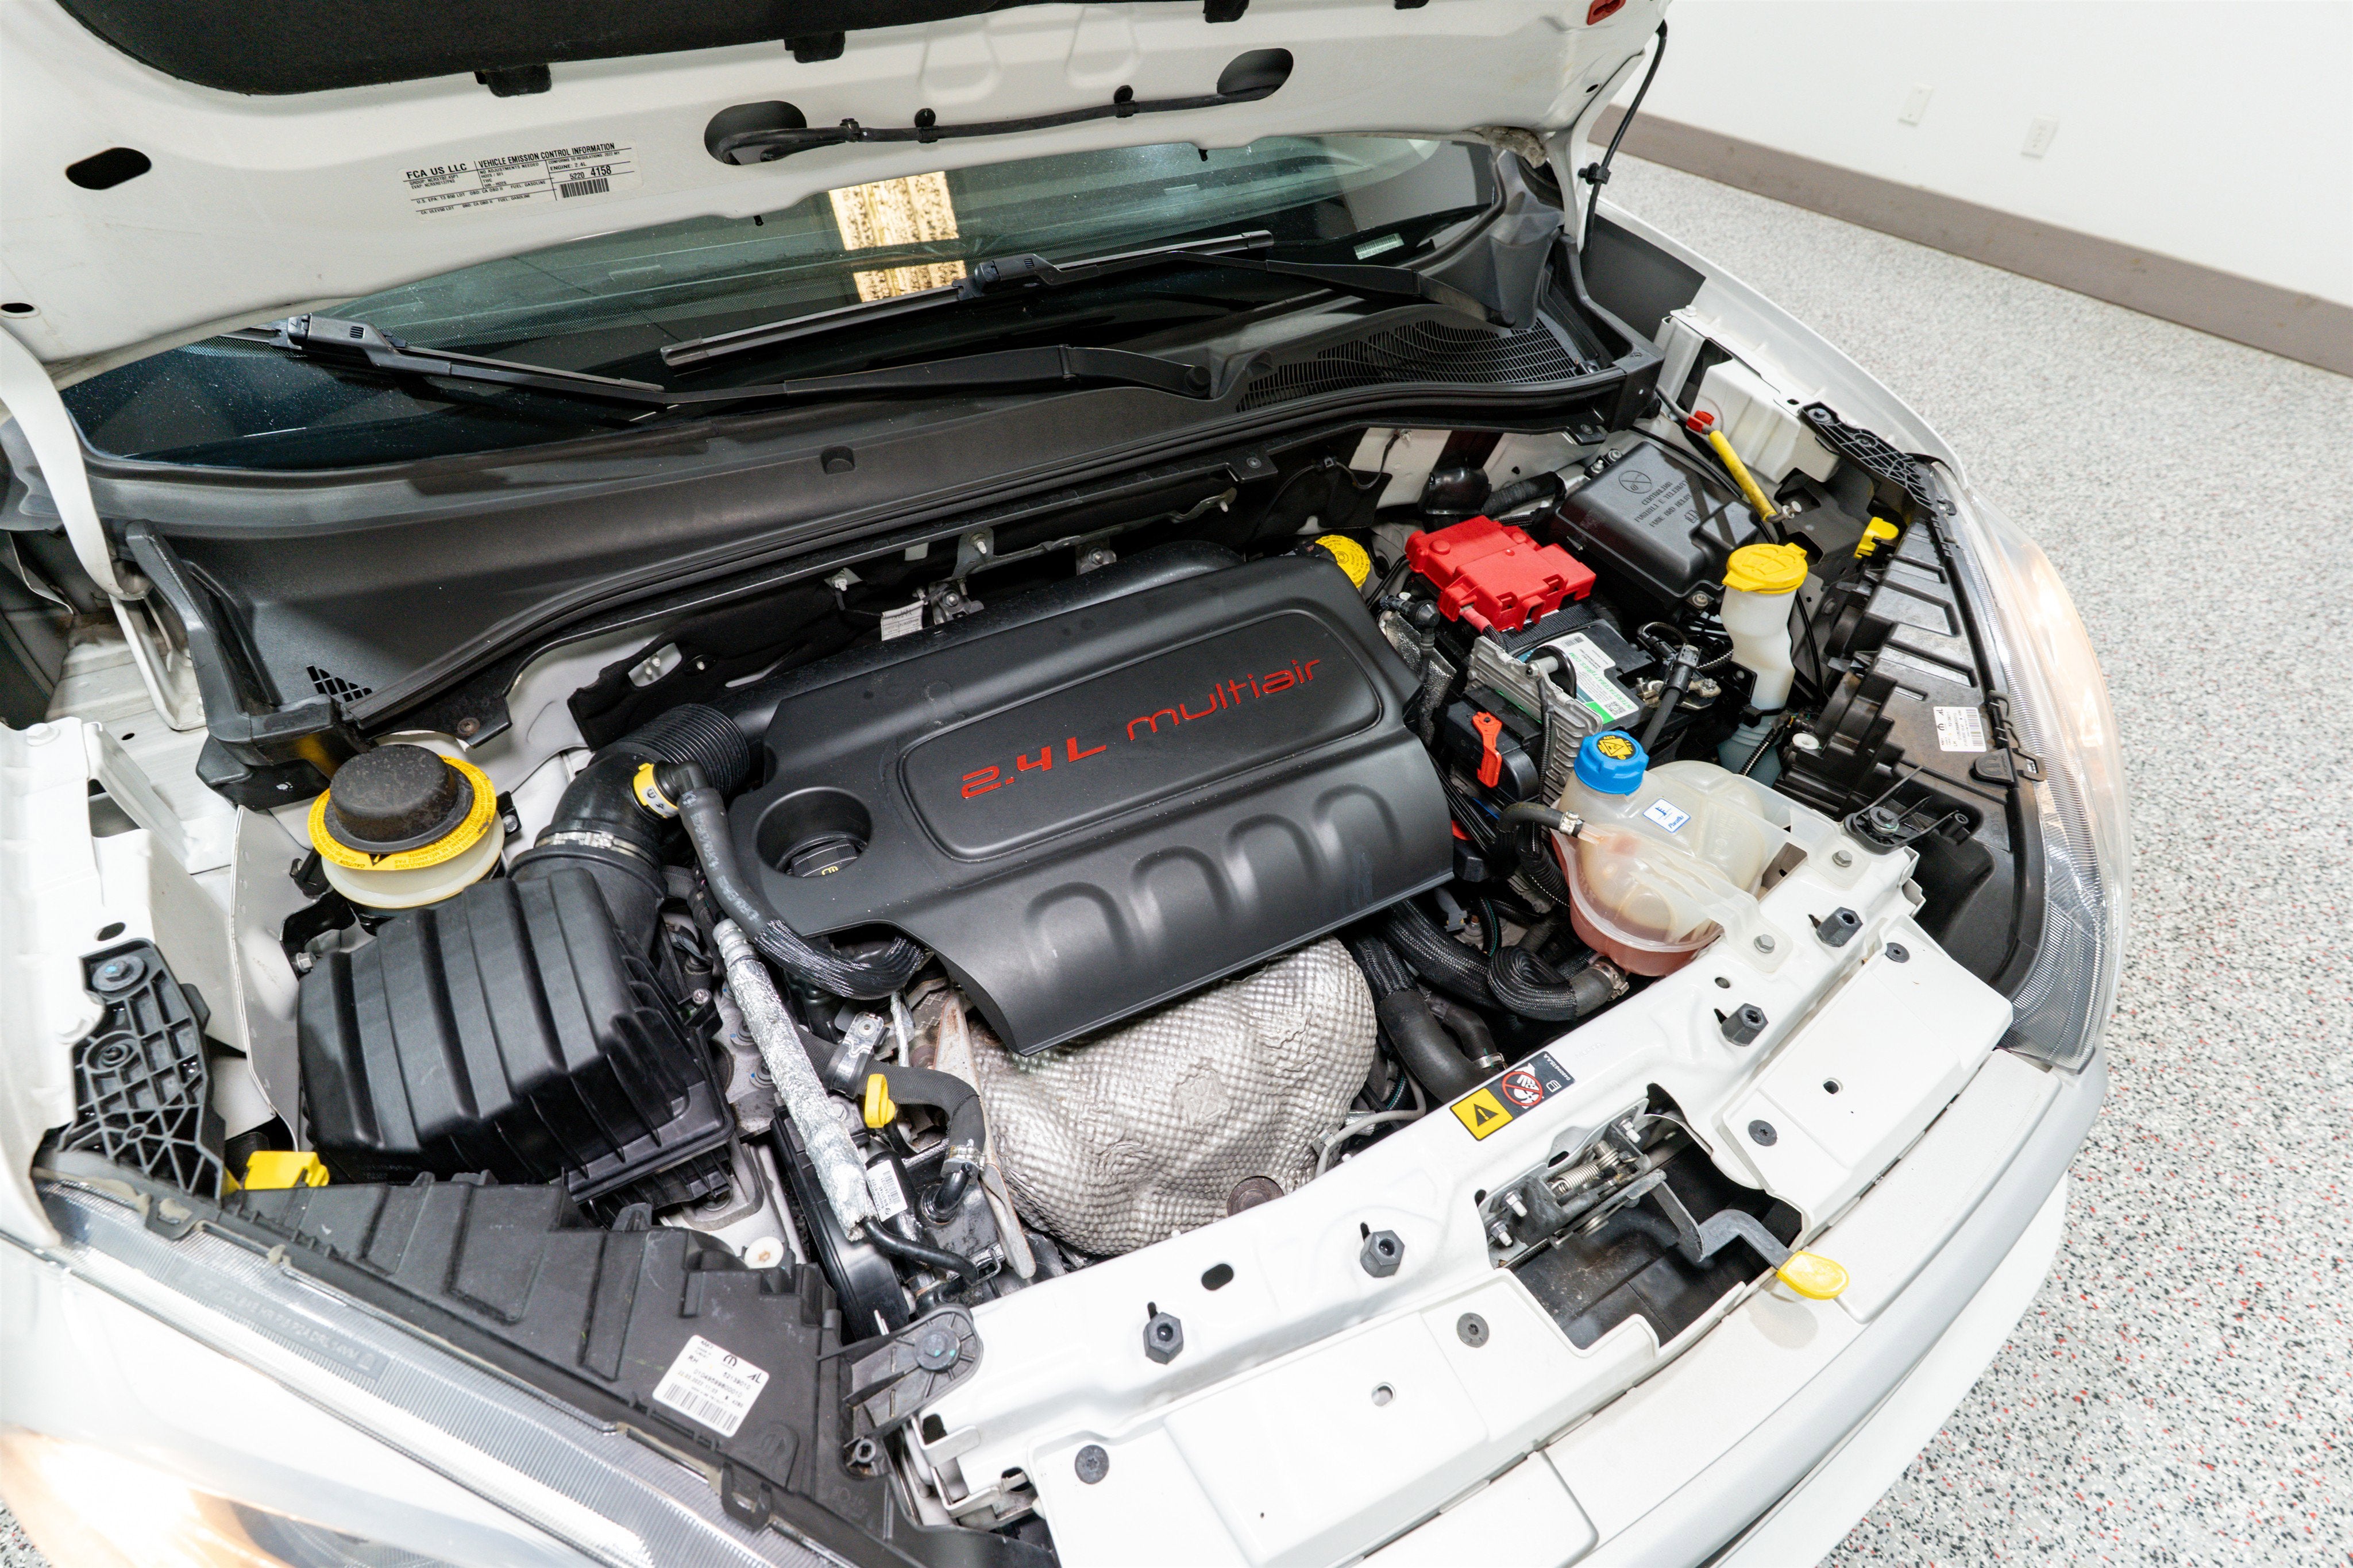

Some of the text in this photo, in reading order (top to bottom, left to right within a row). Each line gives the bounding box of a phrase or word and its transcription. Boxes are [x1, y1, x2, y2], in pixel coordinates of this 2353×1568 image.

[477, 142, 616, 168] VEHICLE EMISSION CONTROL INFORMATION
[406, 163, 468, 179] FCA US LLC
[487, 165, 520, 173] ADJUSTMENTS
[549, 163, 573, 171] ENGINE:
[568, 164, 612, 180] 5220 4158
[524, 179, 546, 187] GASOLINE
[510, 193, 530, 201] GASOLINE
[1648, 513, 1665, 529] FUSE
[1662, 505, 1676, 517] AND
[1673, 492, 1692, 508] RELAY
[1127, 659, 1320, 741] multiair
[340, 859, 364, 868] CAUTION
[688, 1354, 699, 1364] RH
